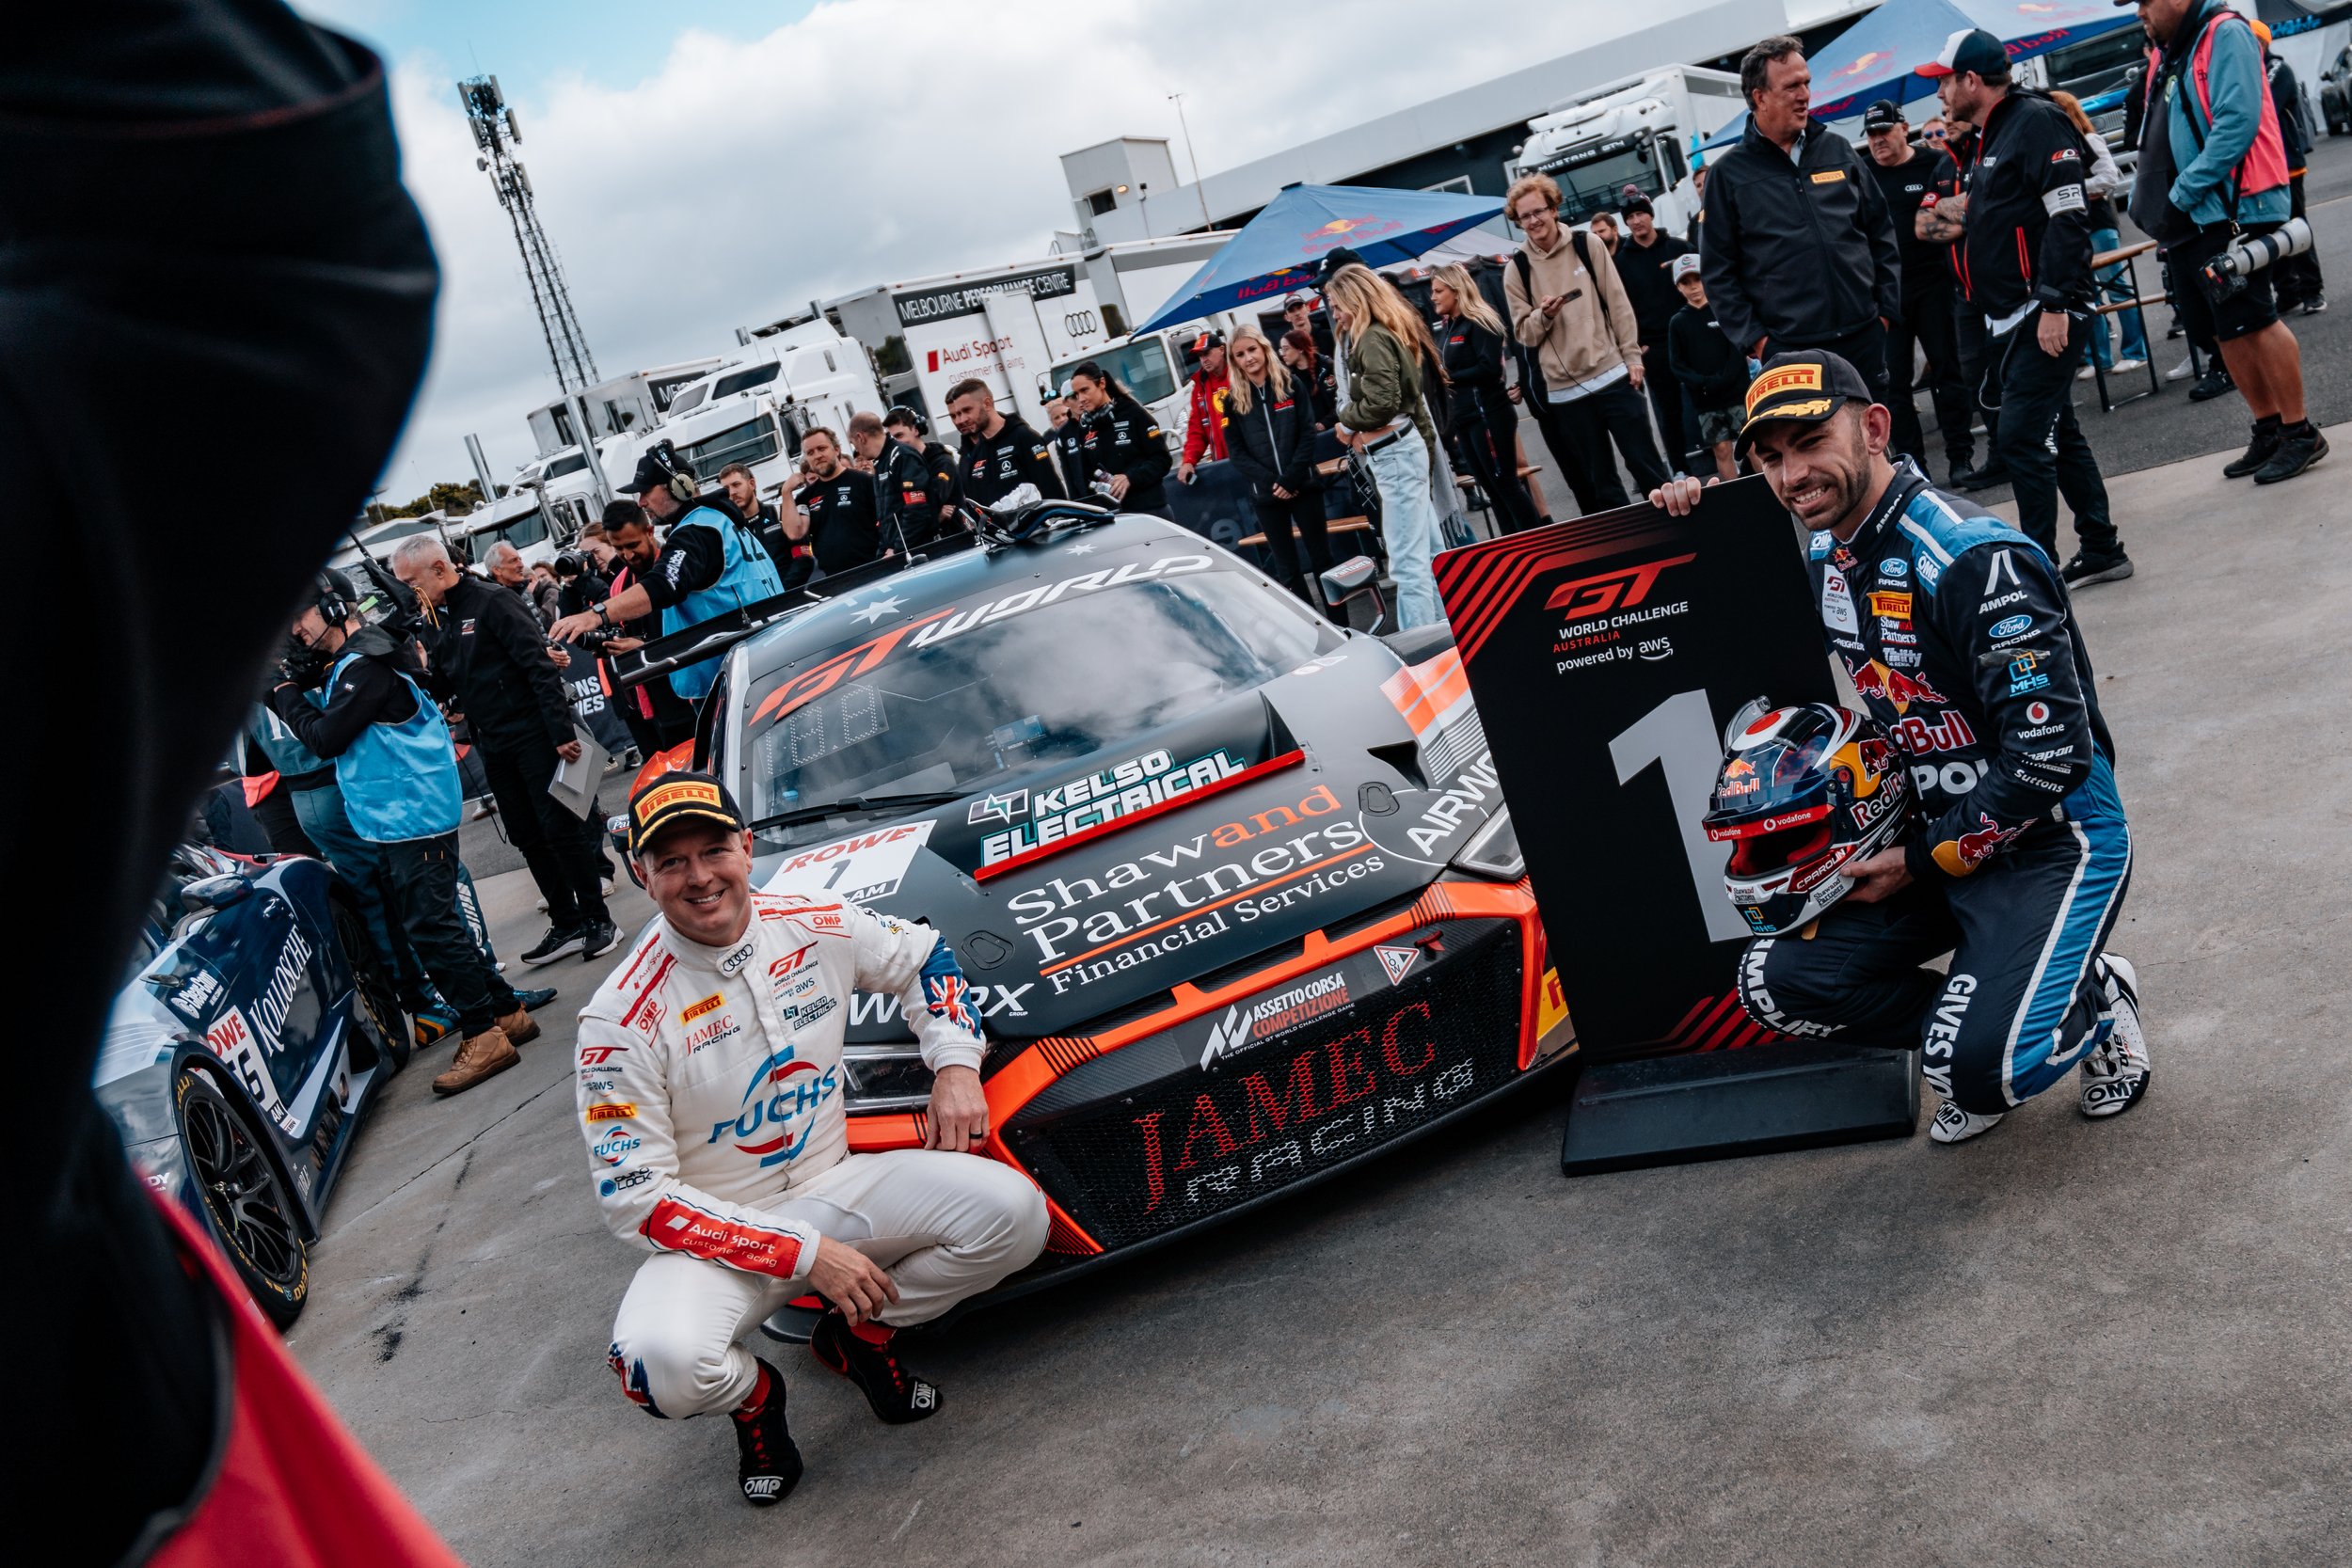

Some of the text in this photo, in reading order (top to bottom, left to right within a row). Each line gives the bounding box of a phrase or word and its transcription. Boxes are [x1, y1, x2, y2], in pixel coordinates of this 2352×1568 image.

[898, 291, 965, 321] MELBOURNE
[1035, 272, 1071, 294] CENTRE
[942, 343, 973, 365] Audi
[1747, 369, 1816, 411] PIRELLI
[1878, 578, 1907, 588] RACING
[1883, 561, 1902, 574] Ford
[1917, 555, 1939, 581] OMP
[1543, 553, 1697, 621] GT
[1979, 590, 2028, 614] AMPOL
[1559, 601, 1689, 640] WORLD CHALLENGE
[1876, 596, 1910, 614] PIRELLI
[748, 608, 956, 727] GT
[908, 555, 1214, 648] WORLD
[1552, 630, 1621, 654] AUSTRALIA
[1881, 627, 1917, 644] Partners
[1991, 628, 2042, 651] RACING
[1998, 619, 2026, 636] Ford
[1556, 637, 1671, 674] powered by aws
[2010, 673, 2049, 693] MHS
[1901, 709, 1977, 756] Bull
[2017, 723, 2065, 739] vodafone
[1035, 750, 1172, 817] KELSO
[2013, 768, 2065, 793] Suttons
[640, 786, 716, 820] PIRELLI
[983, 750, 1245, 868] ELECTRICAL
[1608, 689, 1756, 943] 1
[1850, 784, 1891, 832] Red
[1718, 828, 1741, 838] vodafone
[1776, 812, 1812, 826] vodafone
[783, 826, 918, 875] ROWE
[823, 859, 851, 890] 1
[1023, 820, 1365, 966] Partners
[813, 915, 842, 926] OMP
[1046, 855, 1385, 996] Financial Services
[1752, 924, 1777, 933] MHS
[768, 941, 819, 979] GT
[774, 959, 819, 987] WORLD CHALLENGE
[1384, 950, 1402, 974] TOW
[247, 923, 313, 1058] KOLLOSCHE
[794, 977, 816, 994] aws
[1253, 972, 1346, 1022] ASSETTO CORSA
[639, 1000, 658, 1031] OMP
[683, 995, 723, 1022] PIRELLI
[793, 997, 837, 1031] ELECTRICAL
[800, 995, 828, 1017] KELSO
[1252, 987, 1351, 1039] COMPETIZIONE
[1925, 974, 1977, 1059] GIVES
[206, 1013, 246, 1057] OWE
[686, 1015, 734, 1057] JAMEC
[692, 1024, 741, 1054] RACING
[1221, 1052, 1234, 1061] THE
[1234, 1039, 1264, 1054] OFFICIAL
[1275, 1026, 1298, 1039] WORLD
[1298, 1010, 1337, 1029] CHALLENGE
[1337, 1002, 1356, 1013] GAME
[1922, 1064, 1957, 1106] YO
[589, 1104, 634, 1123] PIRELLI
[708, 1064, 836, 1145] FUCHS
[1132, 1000, 1437, 1215] JAMEC
[1184, 1057, 1475, 1204] RACING
[594, 1137, 641, 1158] FUCHS
[617, 1171, 653, 1191] LOCK
[688, 1223, 729, 1243] Audi
[682, 1237, 778, 1268] customer racing
[915, 1383, 937, 1409] OMP
[744, 1479, 782, 1496] OMP
